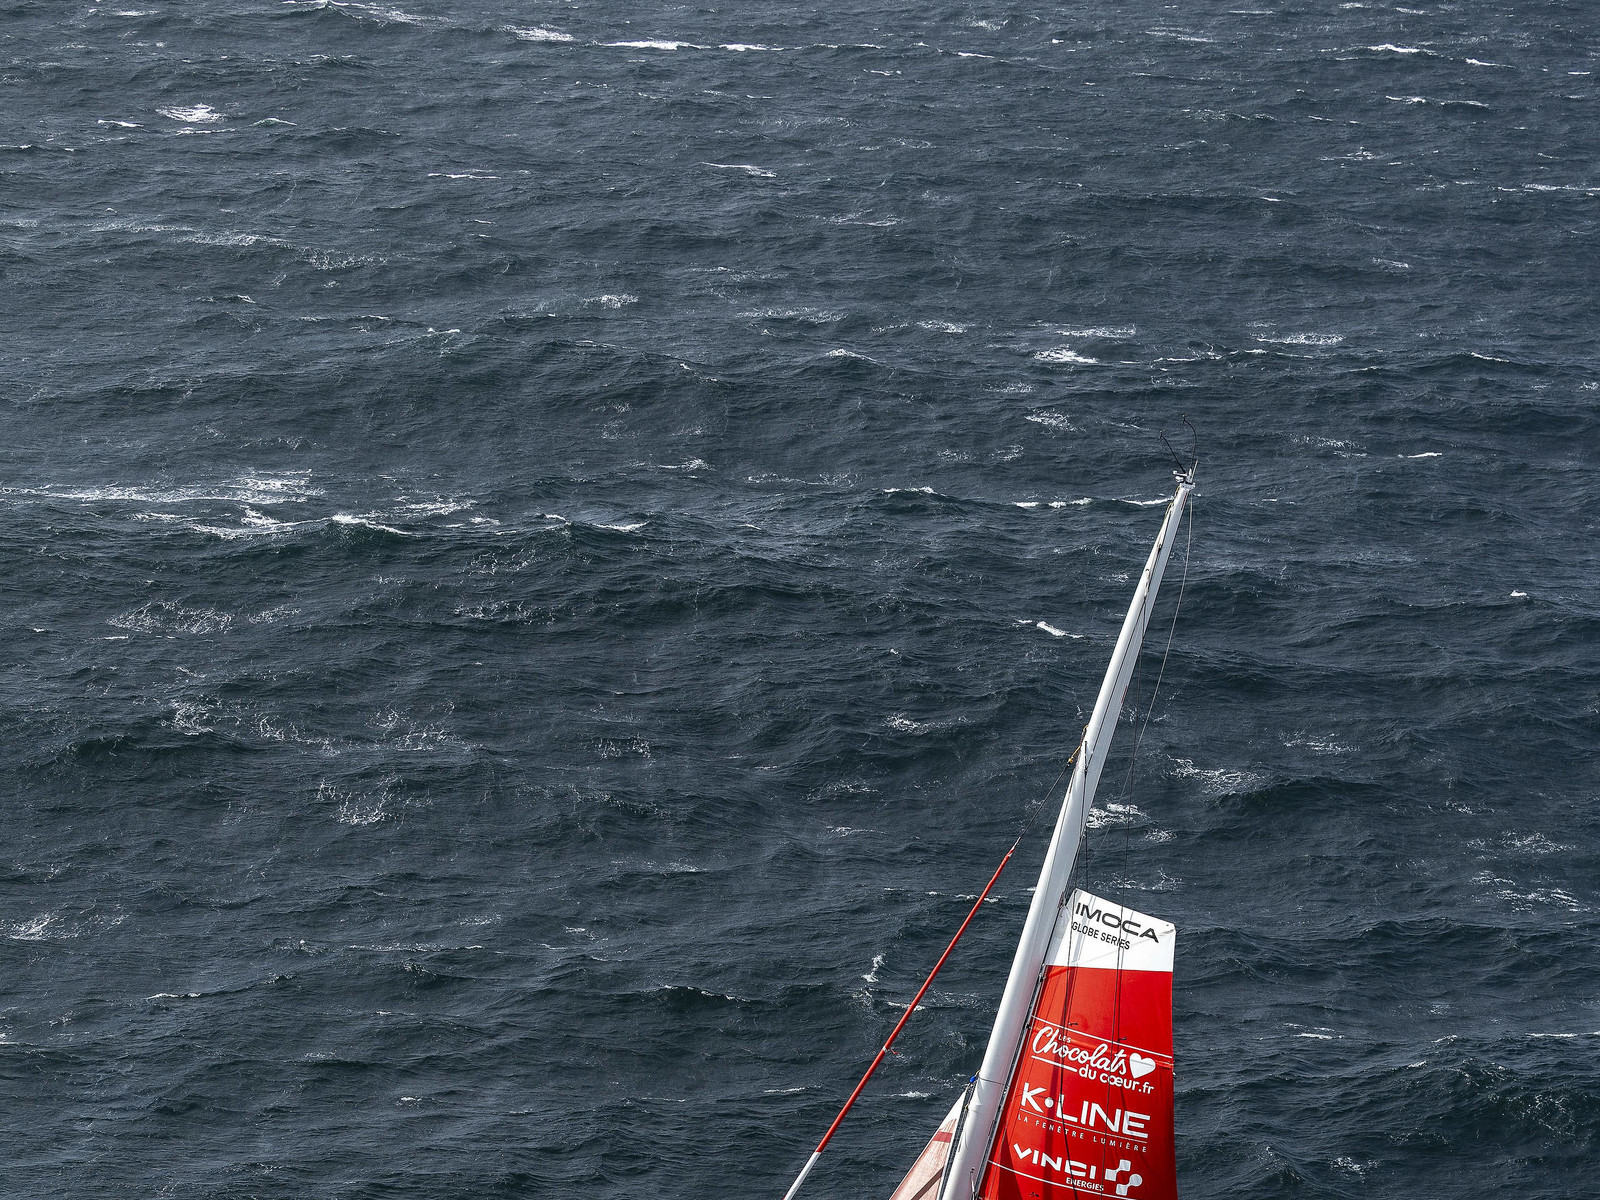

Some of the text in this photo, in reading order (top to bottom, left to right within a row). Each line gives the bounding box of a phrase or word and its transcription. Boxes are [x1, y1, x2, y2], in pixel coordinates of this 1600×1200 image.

[1071, 921, 1131, 951] GLOBE SERIES
[1075, 901, 1160, 944] IMOCA
[1032, 1025, 1127, 1076] Chocolats
[1058, 1034, 1071, 1044] LES
[1078, 1066, 1097, 1081] du
[1017, 1113, 1148, 1154] LA FENÊTRE LUMIÈRE
[1013, 1142, 1096, 1180] VINCI
[1066, 1176, 1105, 1192] ENERGIES
